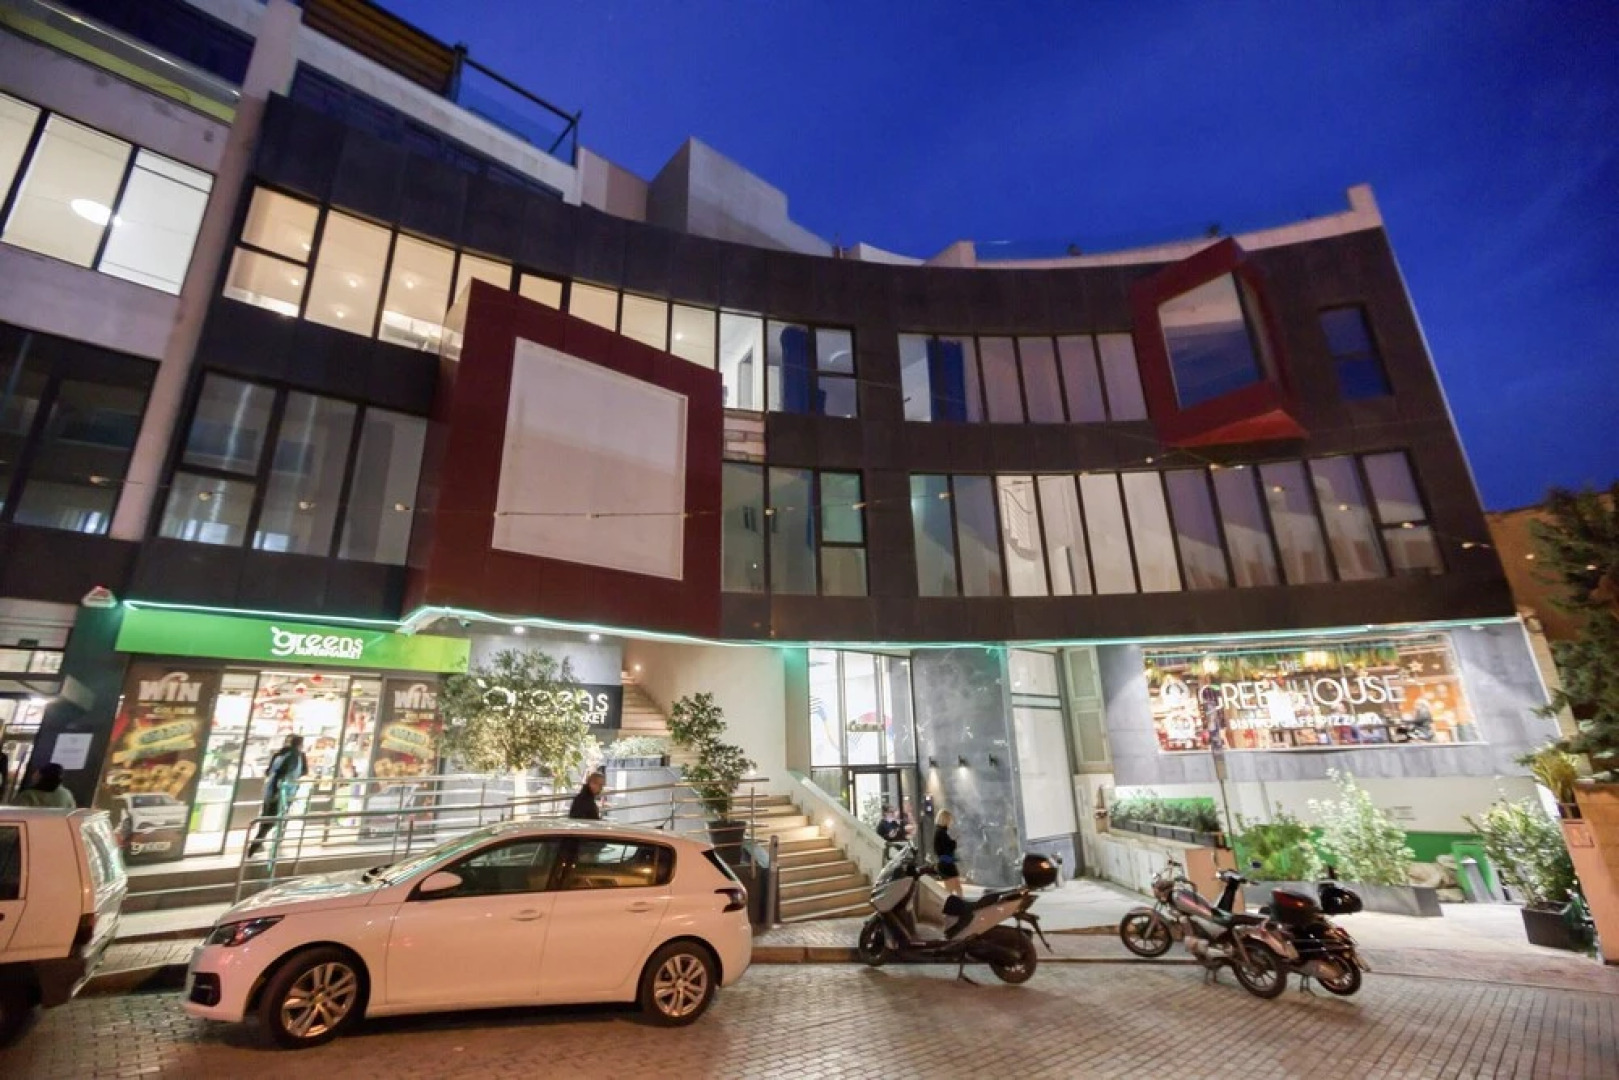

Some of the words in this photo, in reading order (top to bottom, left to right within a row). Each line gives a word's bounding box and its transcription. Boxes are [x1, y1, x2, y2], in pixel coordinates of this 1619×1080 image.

[271, 626, 364, 656] greens
[138, 672, 202, 702] WIN
[394, 683, 438, 710] WIN
